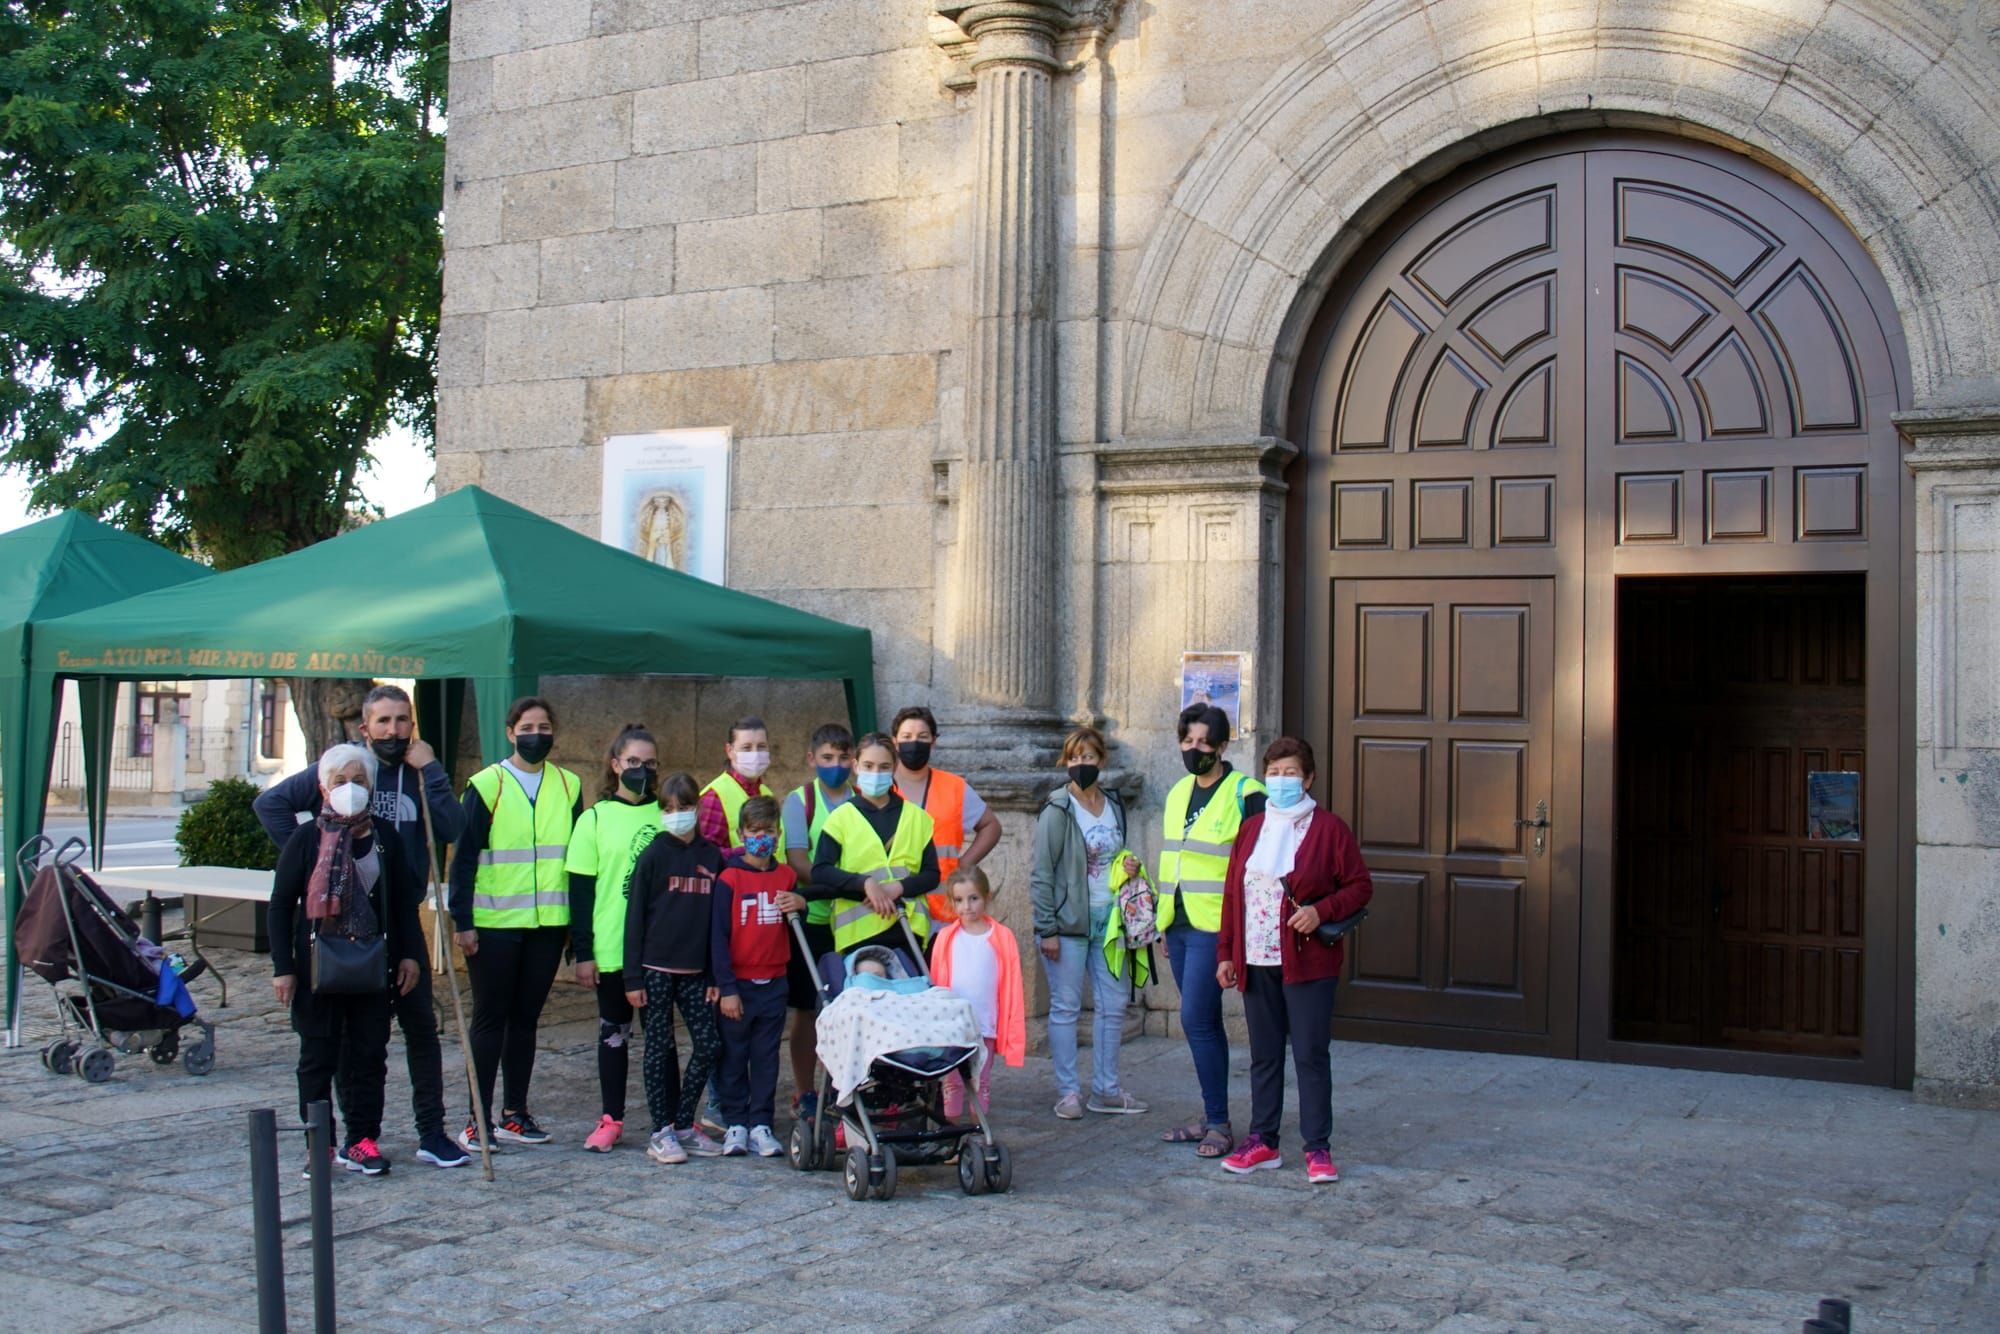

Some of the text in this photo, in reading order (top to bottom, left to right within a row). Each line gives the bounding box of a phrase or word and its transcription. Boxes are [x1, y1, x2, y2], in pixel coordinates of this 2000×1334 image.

[103, 648, 265, 669] AYUNTAMIENTO
[268, 651, 298, 670] DE
[304, 649, 425, 675] ALCAÑICES
[376, 791, 397, 801] THE
[374, 801, 396, 811] RTH
[668, 876, 711, 894] PUMA
